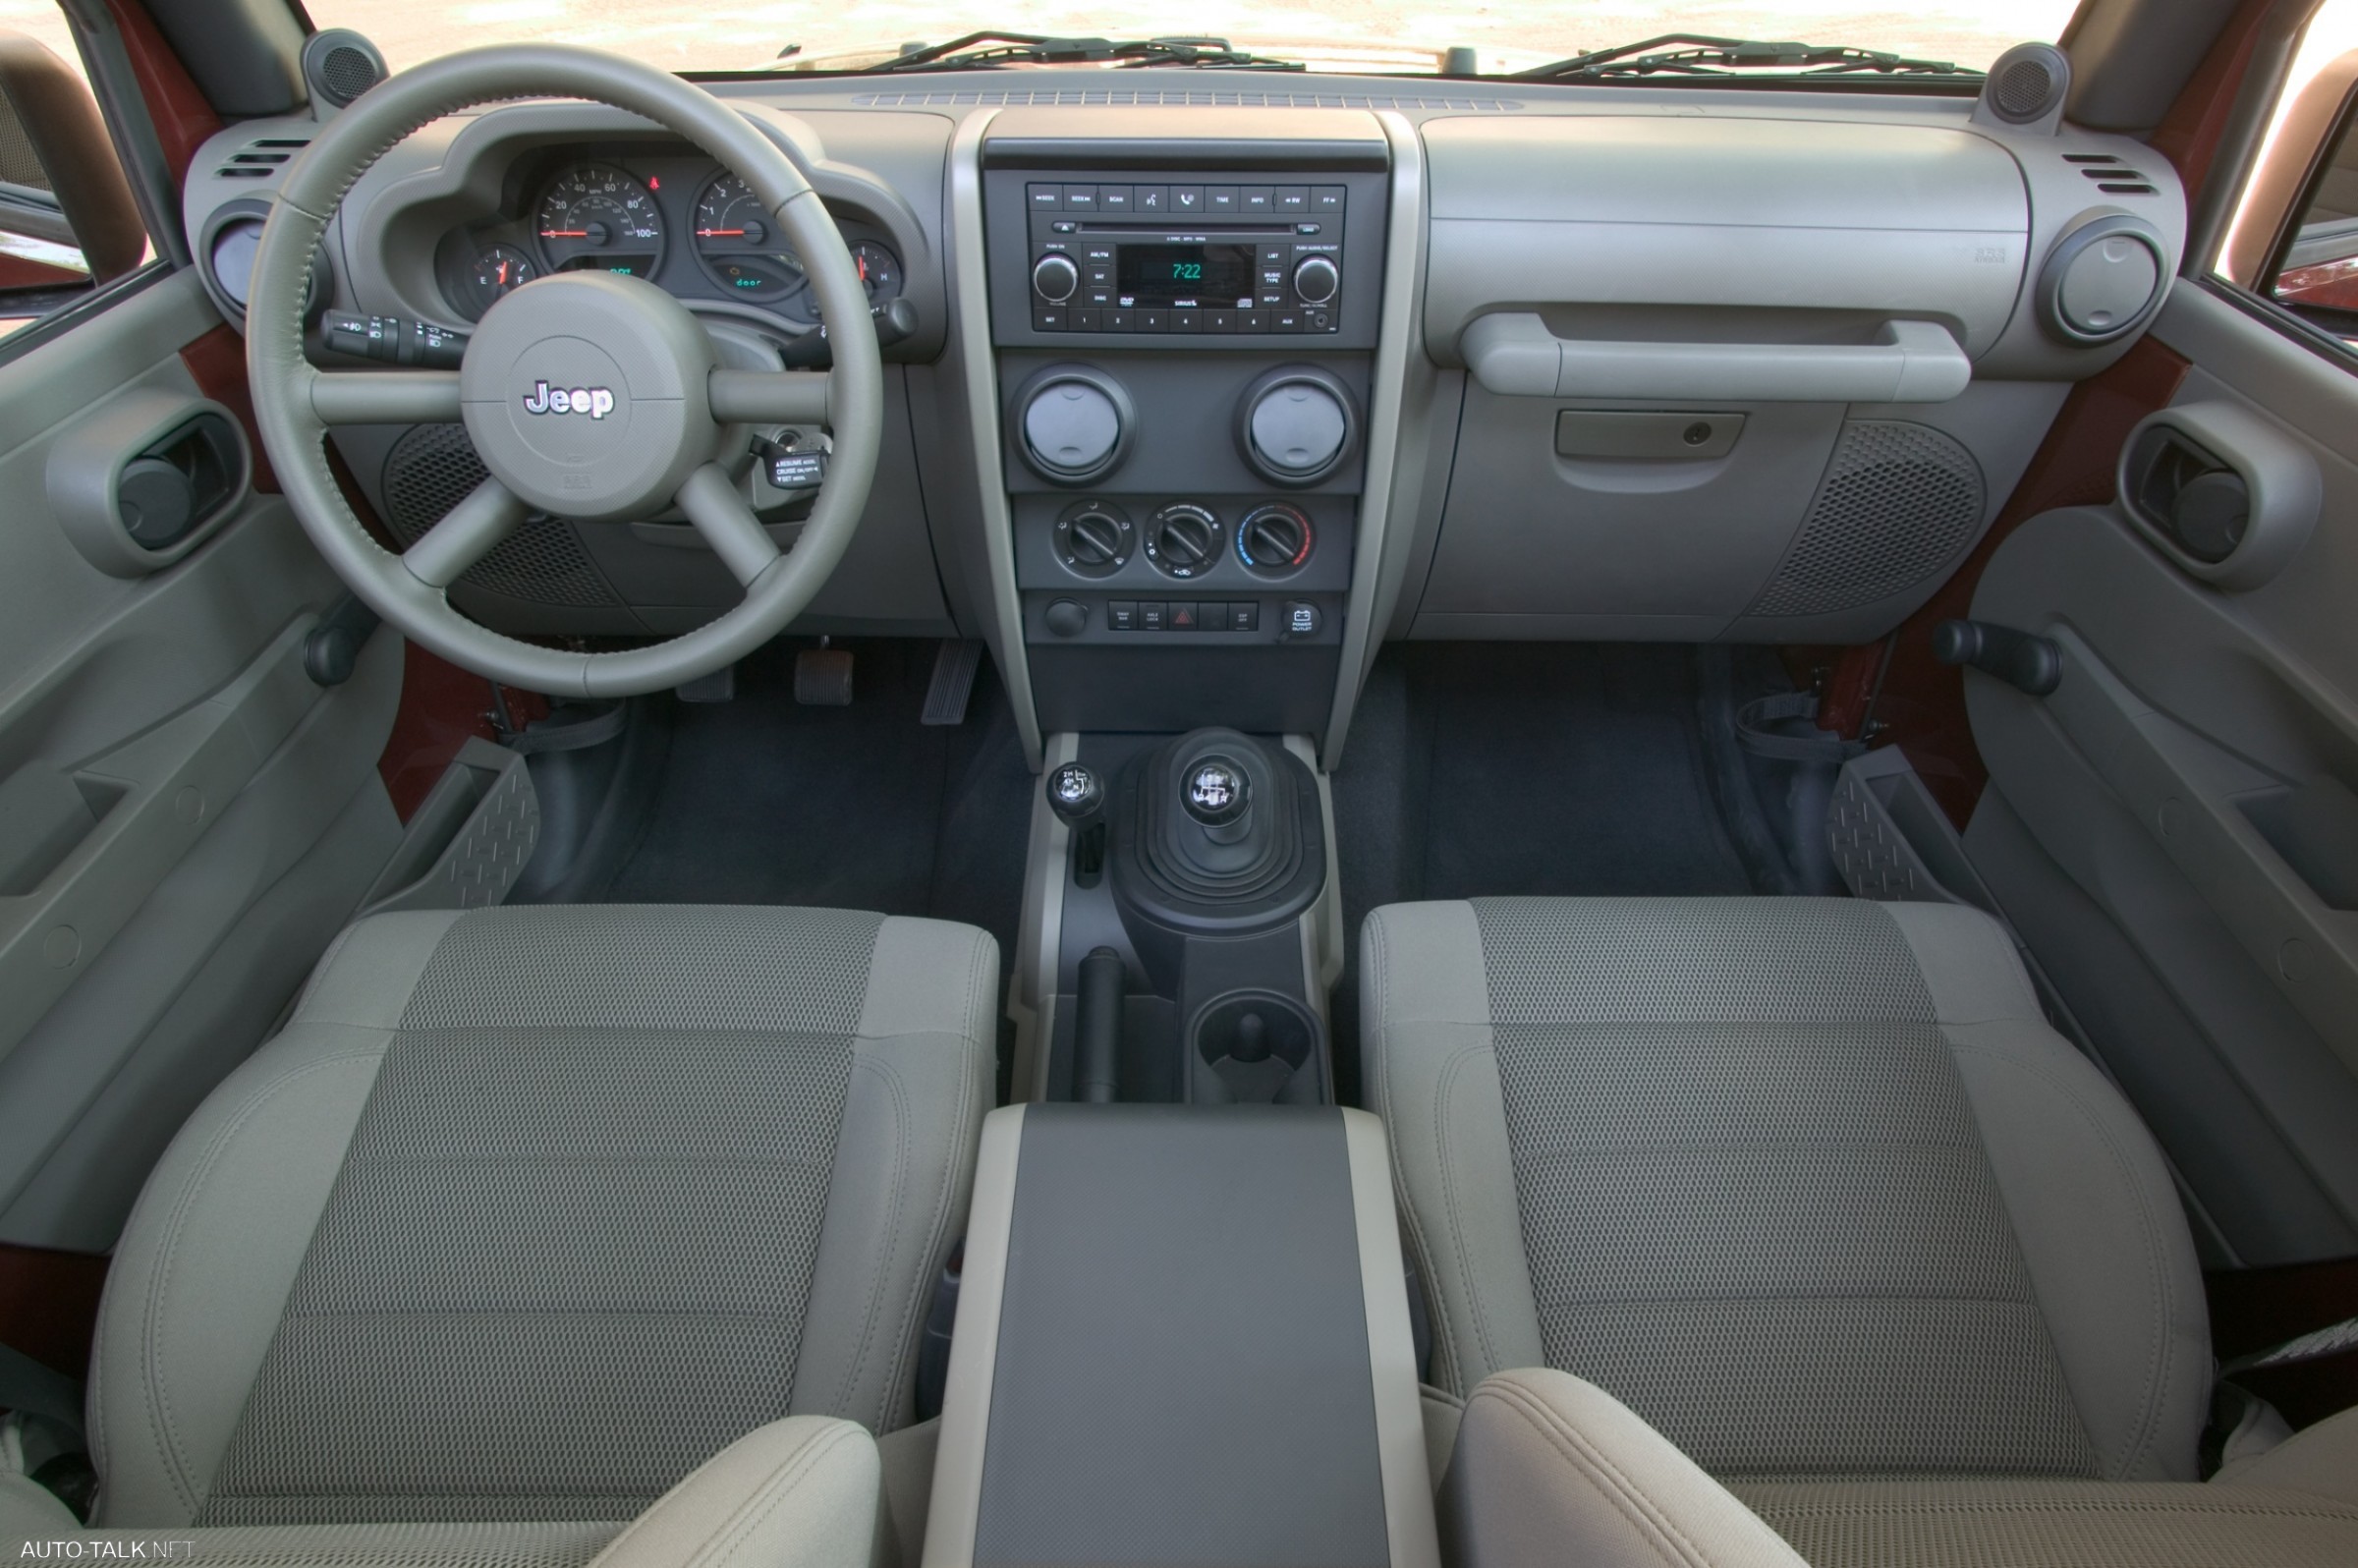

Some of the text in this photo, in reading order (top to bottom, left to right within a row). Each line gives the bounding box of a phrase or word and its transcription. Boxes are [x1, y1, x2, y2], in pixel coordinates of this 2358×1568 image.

[574, 184, 586, 193] 40
[604, 184, 616, 193] 60
[720, 189, 726, 197] 2
[555, 200, 567, 209] 20
[627, 199, 639, 208] 80
[709, 206, 714, 215] 1
[636, 229, 651, 238] 100
[1172, 263, 1201, 279] 7:22
[479, 276, 487, 285] E
[523, 379, 615, 420] Jeep
[780, 459, 803, 468] RESUME
